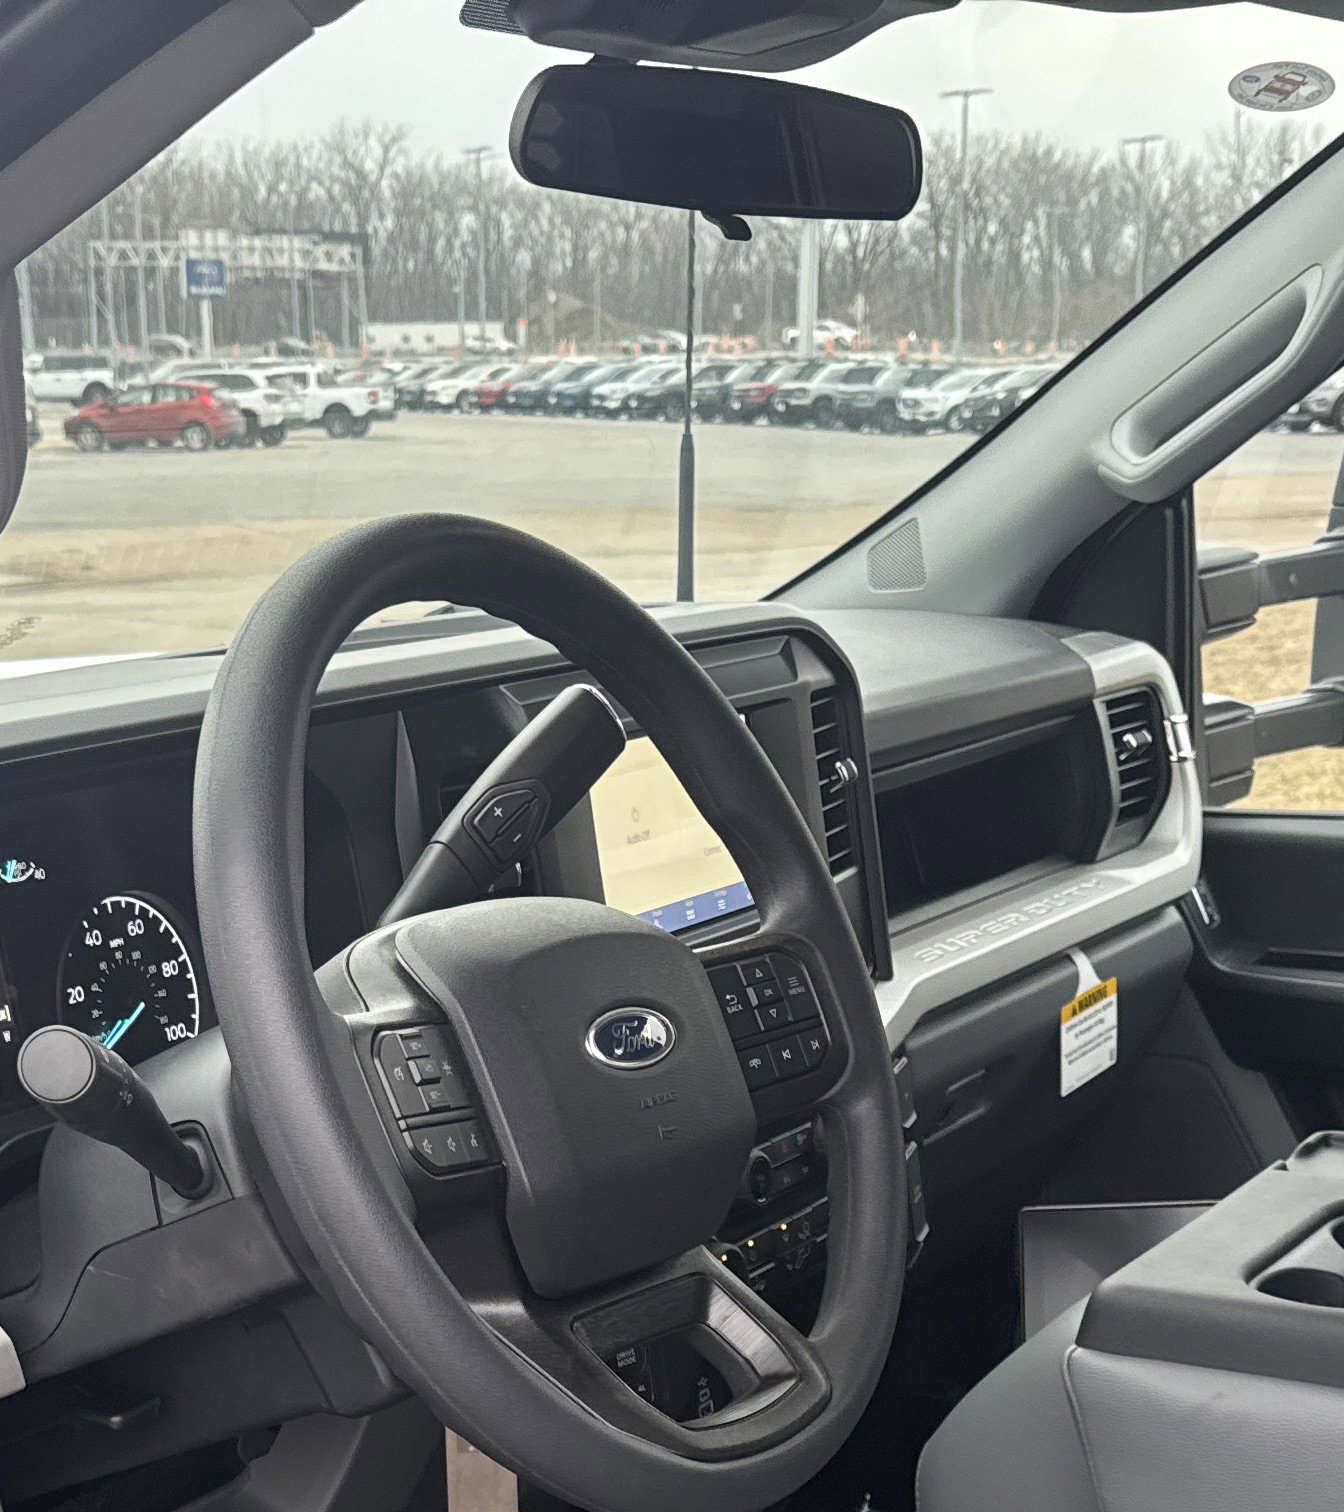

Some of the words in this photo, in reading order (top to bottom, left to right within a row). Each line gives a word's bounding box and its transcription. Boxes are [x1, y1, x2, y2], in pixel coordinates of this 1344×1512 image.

[127, 919, 145, 937] 60
[914, 911, 1029, 964] SUPER
[1023, 878, 1106, 917] DUTY
[84, 929, 103, 947] 40
[161, 960, 179, 978] 80
[66, 986, 85, 1005] 20
[726, 1004, 744, 1014] BACK
[164, 1022, 187, 1042] 100
[611, 1020, 656, 1058] Ford
